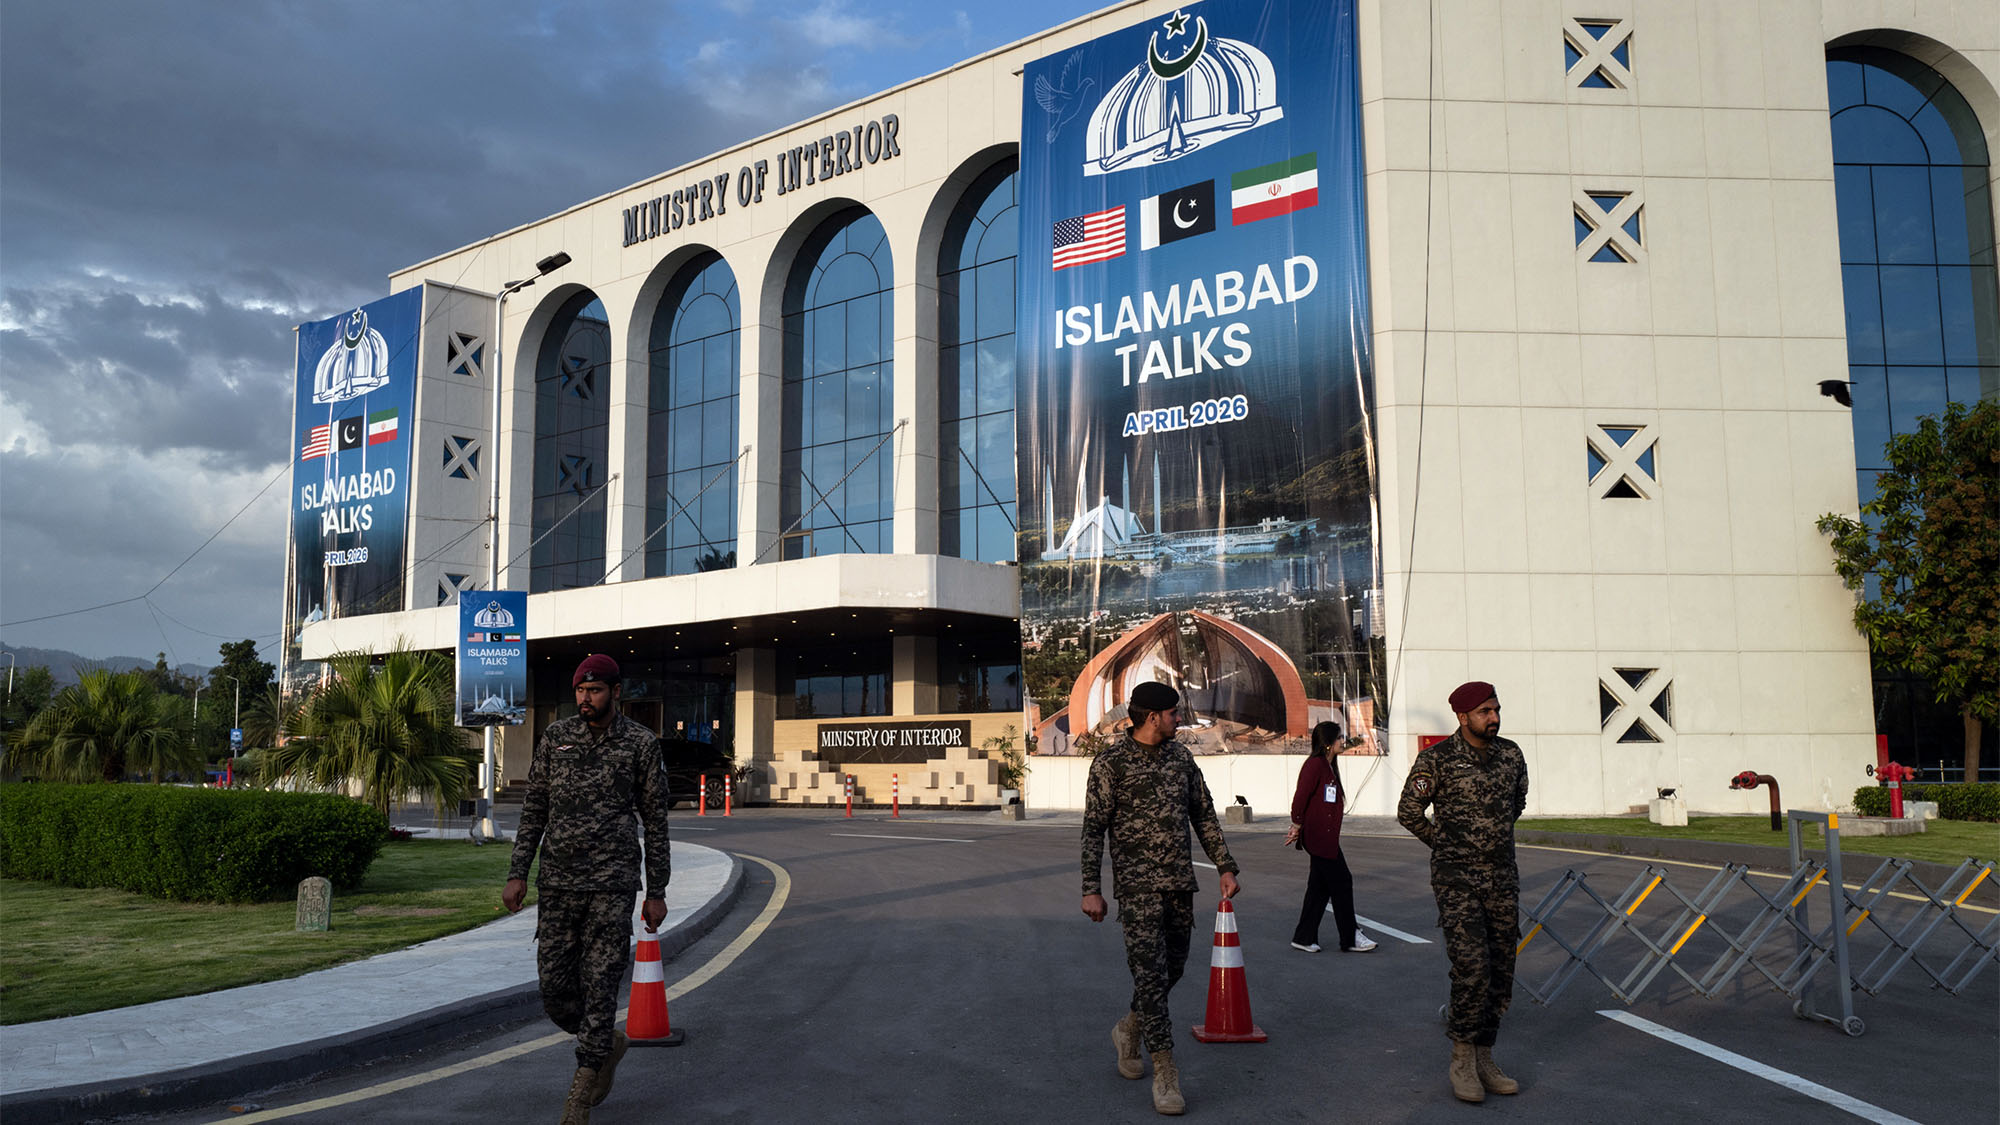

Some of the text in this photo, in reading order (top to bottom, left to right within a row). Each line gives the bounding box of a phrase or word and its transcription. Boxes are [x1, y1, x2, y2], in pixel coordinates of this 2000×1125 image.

[622, 113, 901, 247] MINISTRY OF INTERIOR
[1055, 255, 1319, 349] ISLAMABAD
[1115, 322, 1252, 387] TALKS
[1122, 394, 1249, 437] APRIL 2026
[302, 468, 396, 512] ISLAMABAD
[321, 503, 373, 537] TALKS
[323, 550, 347, 568] PRIL
[467, 648, 520, 657] ISLAMABAD
[480, 657, 508, 666] TALKS
[821, 727, 963, 748] MINISTRY OF INTERIOR
